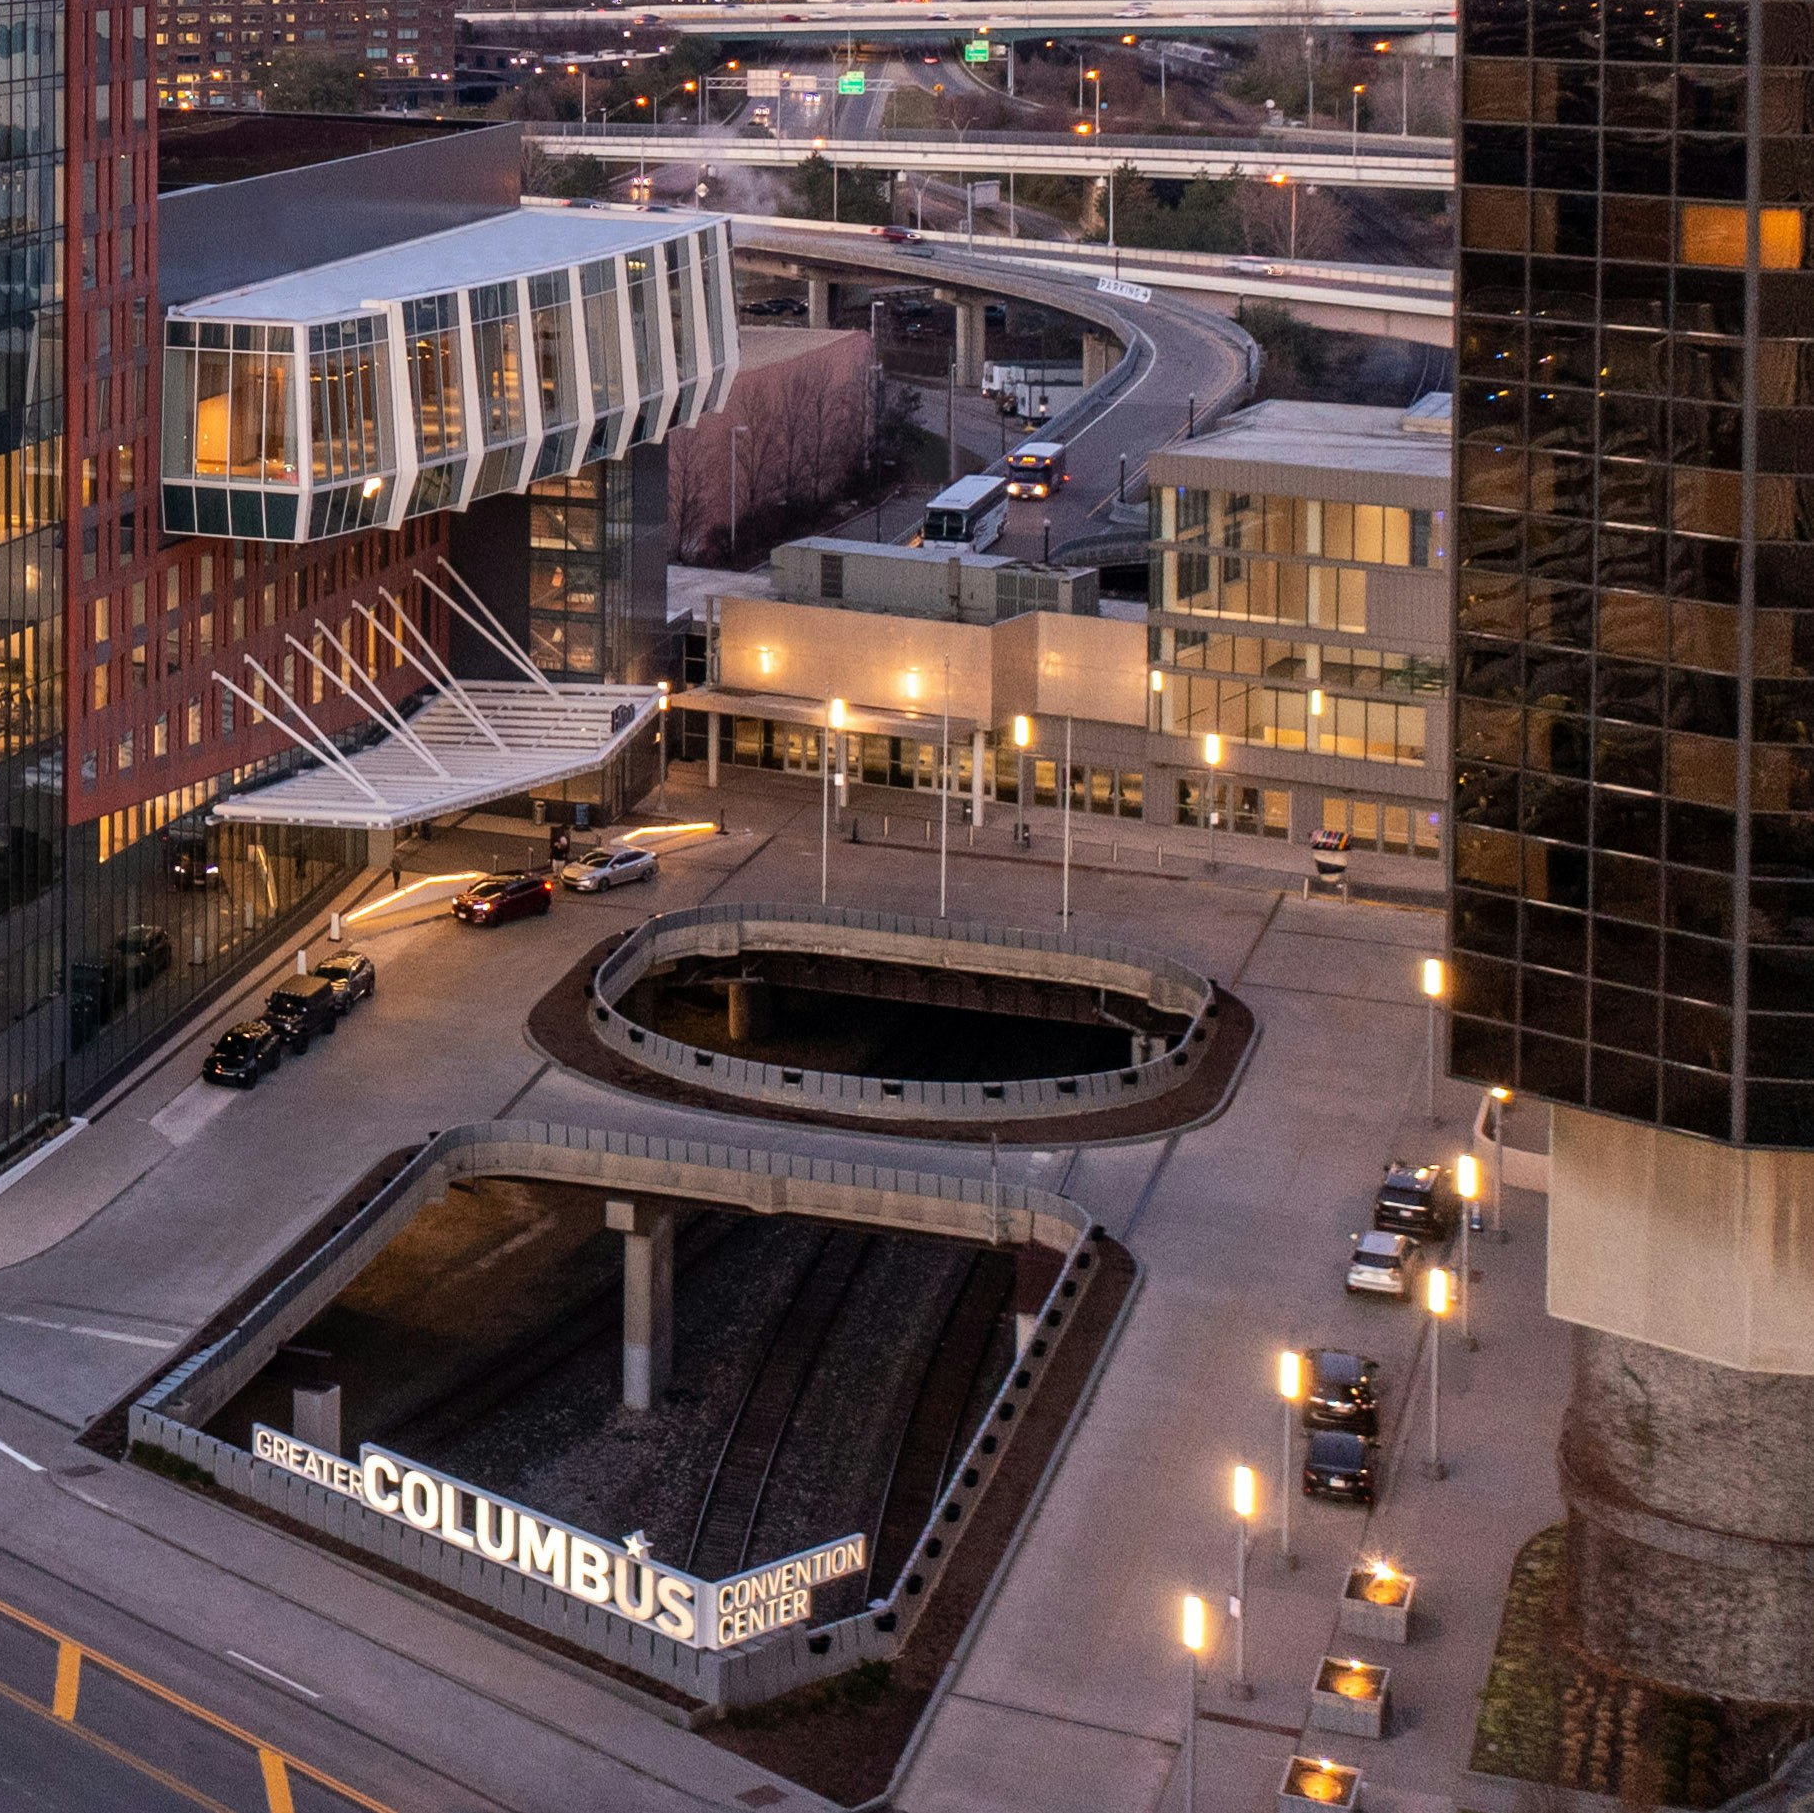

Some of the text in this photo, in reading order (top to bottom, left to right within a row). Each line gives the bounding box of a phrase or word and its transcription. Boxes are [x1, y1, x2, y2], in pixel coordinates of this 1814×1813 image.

[1100, 279, 1140, 298] PARKING
[256, 1431, 363, 1495] GREATER
[363, 1454, 695, 1639] COLUMBUS
[718, 1540, 864, 1614] CONVENTION
[718, 1589, 808, 1644] CENTER
